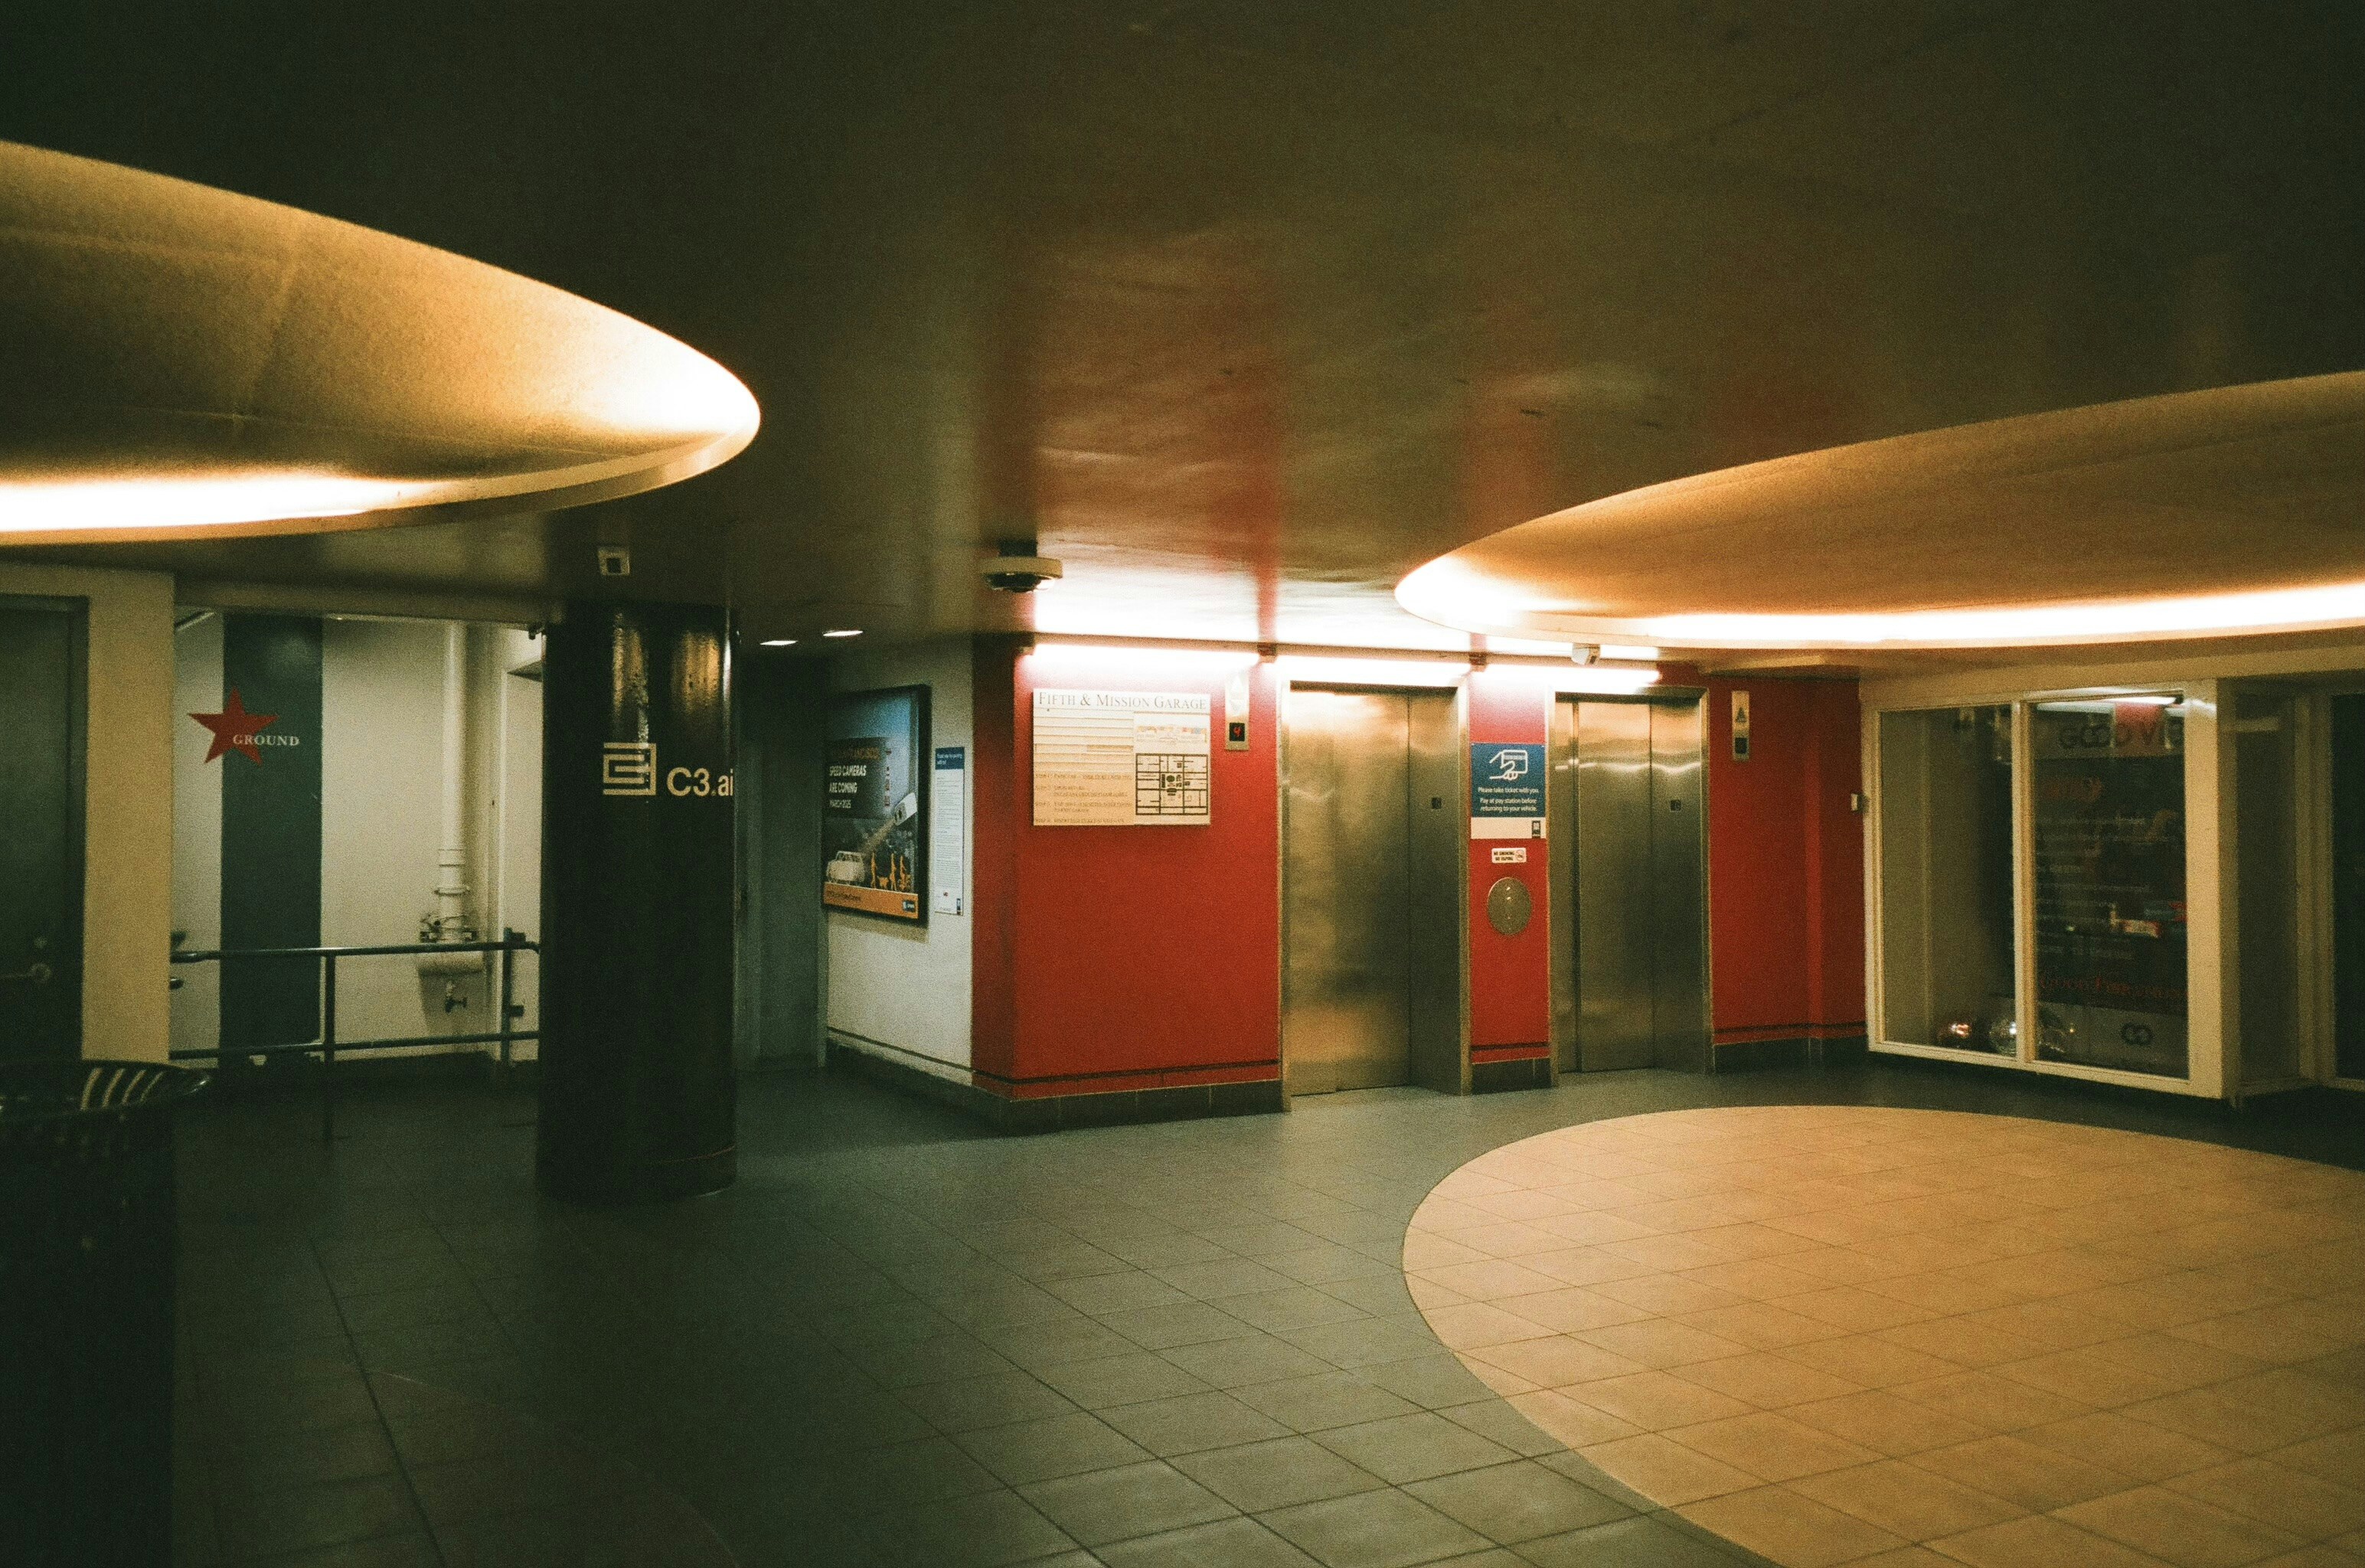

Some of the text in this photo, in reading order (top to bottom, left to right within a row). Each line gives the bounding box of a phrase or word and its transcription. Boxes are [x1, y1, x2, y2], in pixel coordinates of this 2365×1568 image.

[1039, 691, 1206, 709] FIFTH & MISSION GARAGE
[233, 734, 299, 746] GROUND
[829, 765, 867, 776] SPEED CAMERAS
[666, 766, 733, 796] C3.ai
[838, 782, 857, 793] COMING
